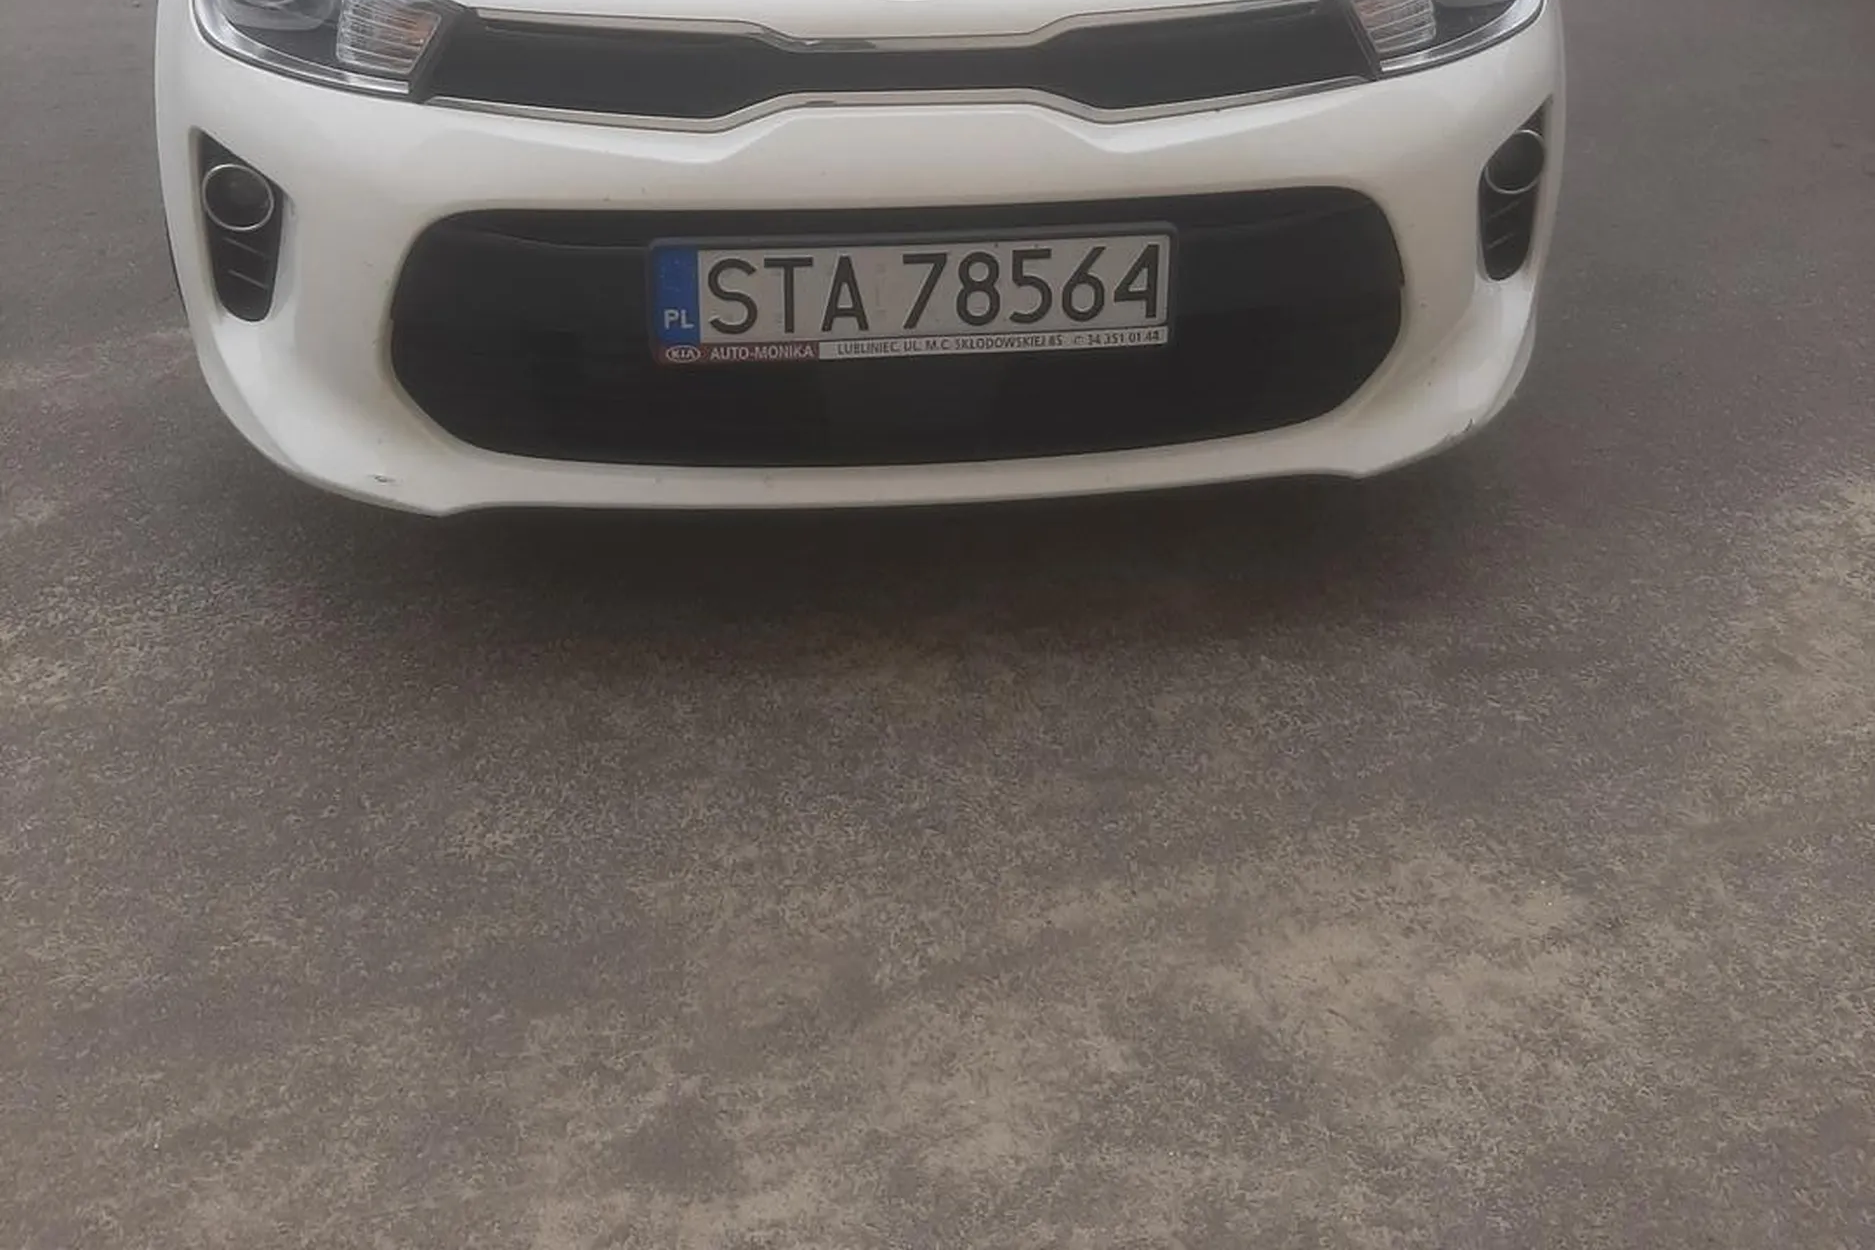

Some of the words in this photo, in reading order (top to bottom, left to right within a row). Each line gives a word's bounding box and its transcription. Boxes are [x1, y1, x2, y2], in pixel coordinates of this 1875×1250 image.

[707, 255, 870, 334] STA
[902, 243, 1160, 330] 78564
[664, 310, 695, 329] PL
[709, 345, 815, 361] AUTO-MONIKA
